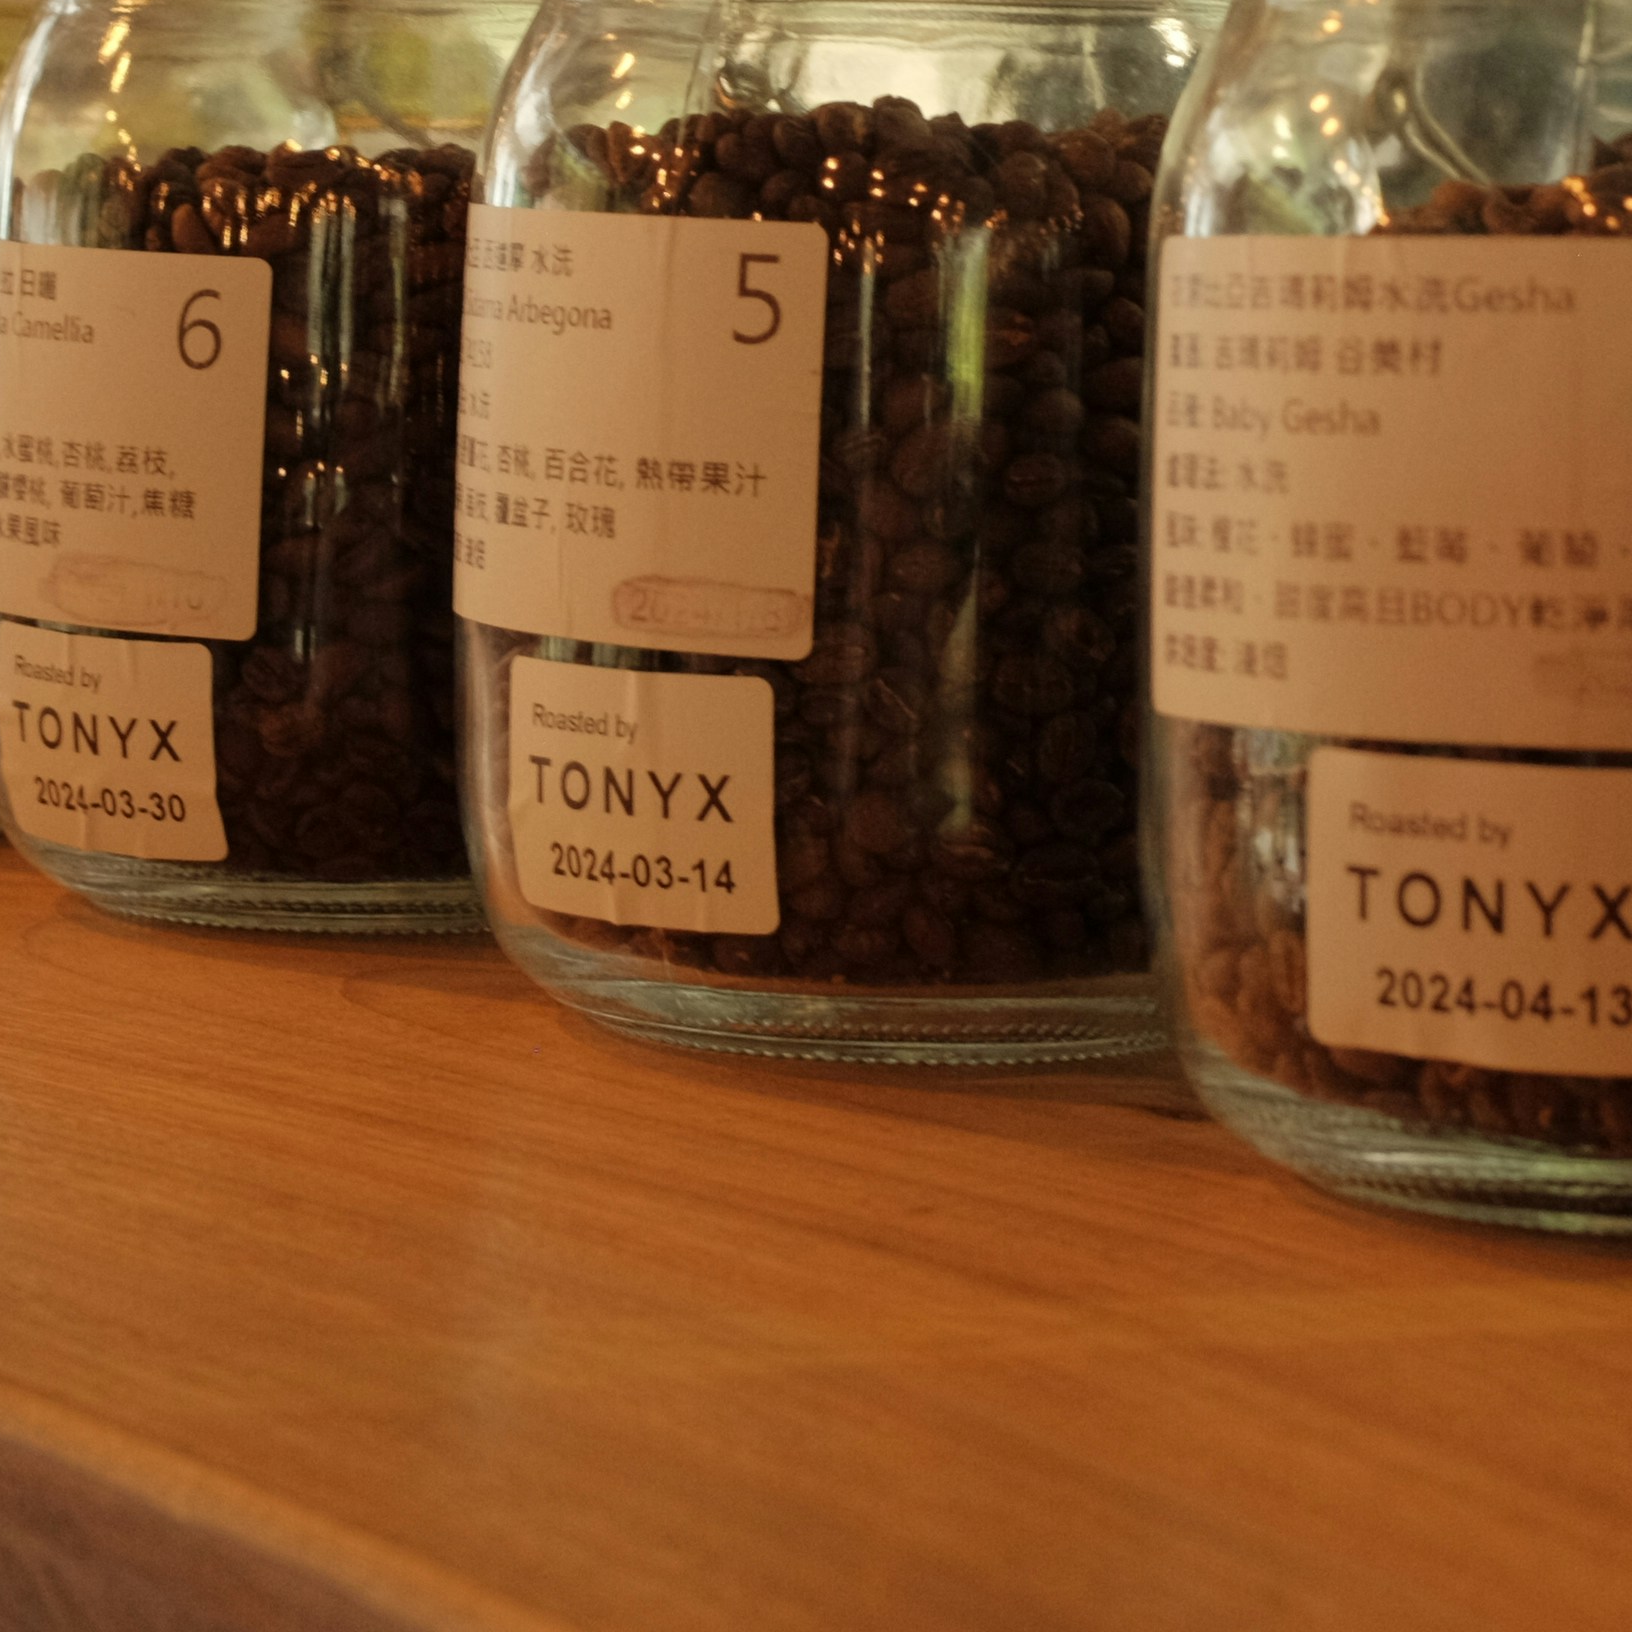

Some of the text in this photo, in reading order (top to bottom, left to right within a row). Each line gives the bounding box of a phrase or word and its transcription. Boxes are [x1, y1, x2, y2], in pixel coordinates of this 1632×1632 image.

[531, 243, 574, 278] 水洗
[506, 293, 614, 336] Arbegona
[730, 251, 783, 345] 5
[12, 311, 95, 345] Camellia
[177, 288, 223, 371] 6
[1281, 396, 1382, 438] Gesha
[634, 455, 768, 499] 熱帶果汁
[565, 500, 617, 540] 玫瑰
[14, 654, 102, 695] Roasted by
[11, 699, 182, 763] TONYX
[531, 702, 638, 745] Roasted by
[34, 775, 186, 823] 2024-03-30
[528, 754, 734, 823] TONYX
[1348, 800, 1515, 851] Roasted by
[550, 841, 736, 894] 2024-03-14
